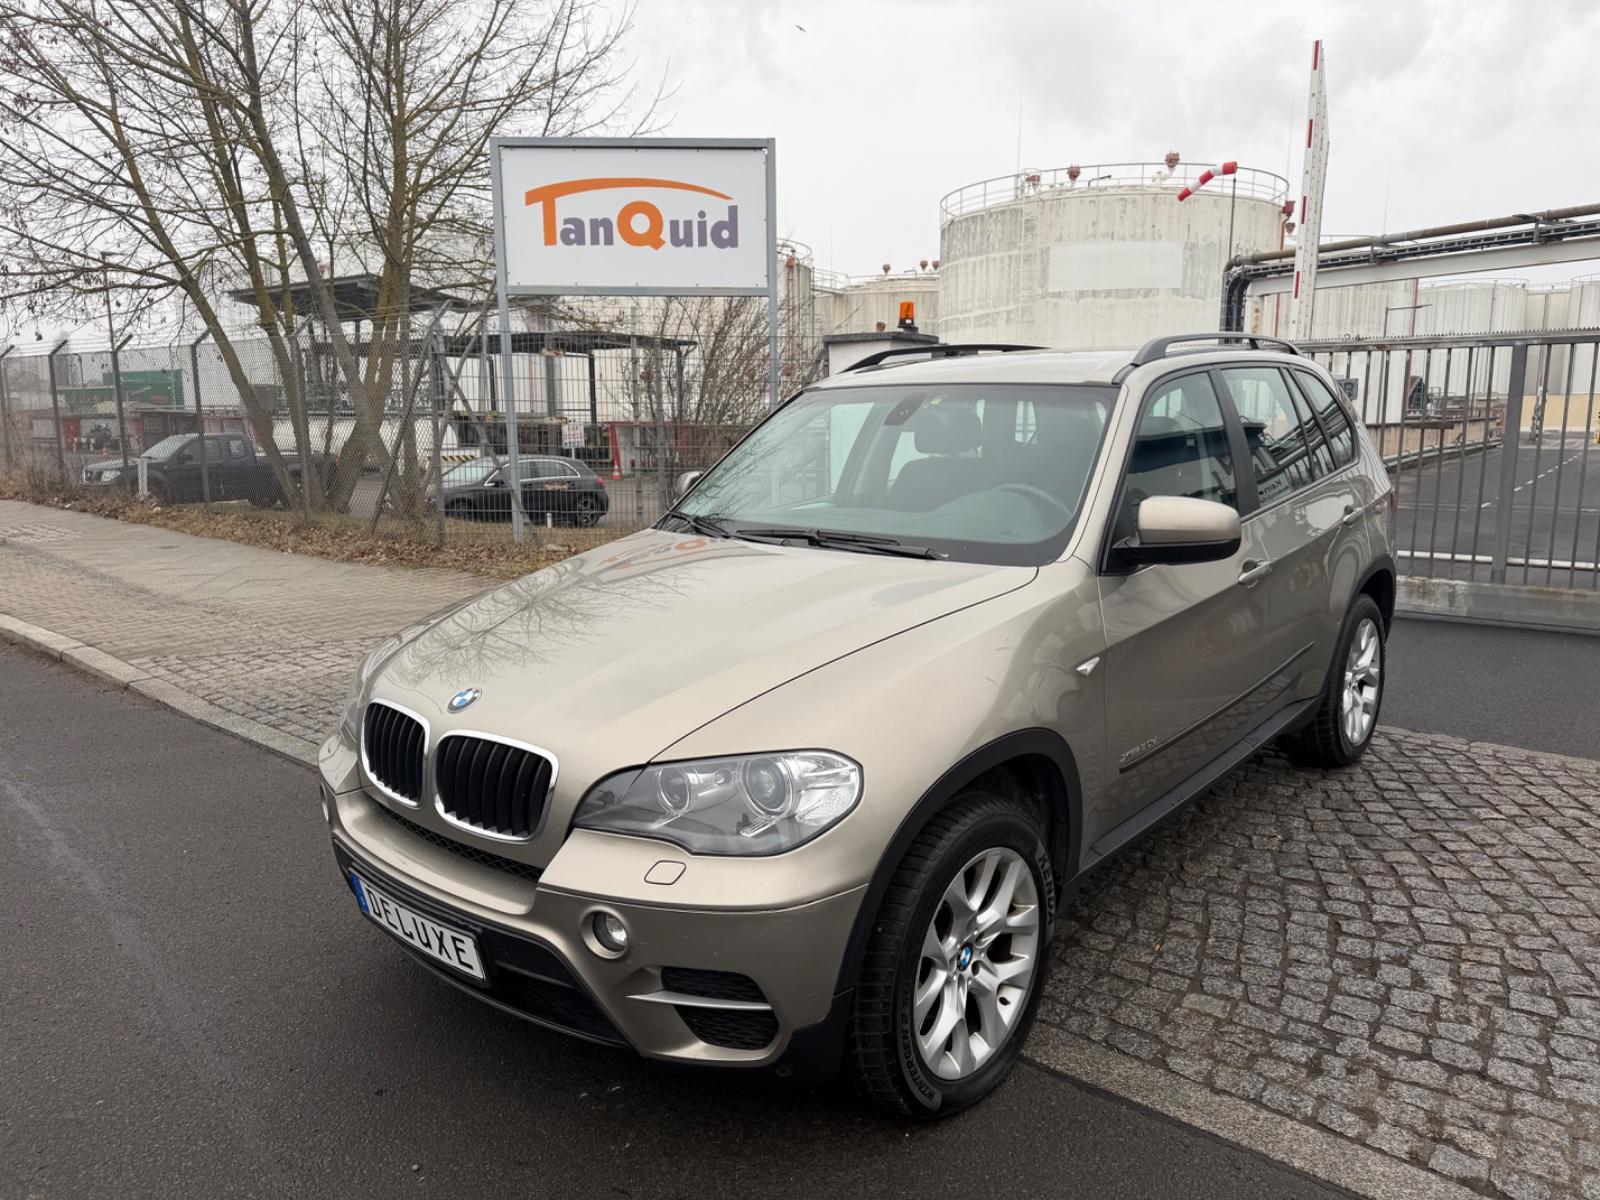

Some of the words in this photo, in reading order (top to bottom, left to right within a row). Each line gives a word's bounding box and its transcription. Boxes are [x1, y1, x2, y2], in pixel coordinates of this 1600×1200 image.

[524, 177, 738, 251] TanQuid
[1038, 853, 1056, 927] KENDA
[364, 886, 474, 970] DELUXE
